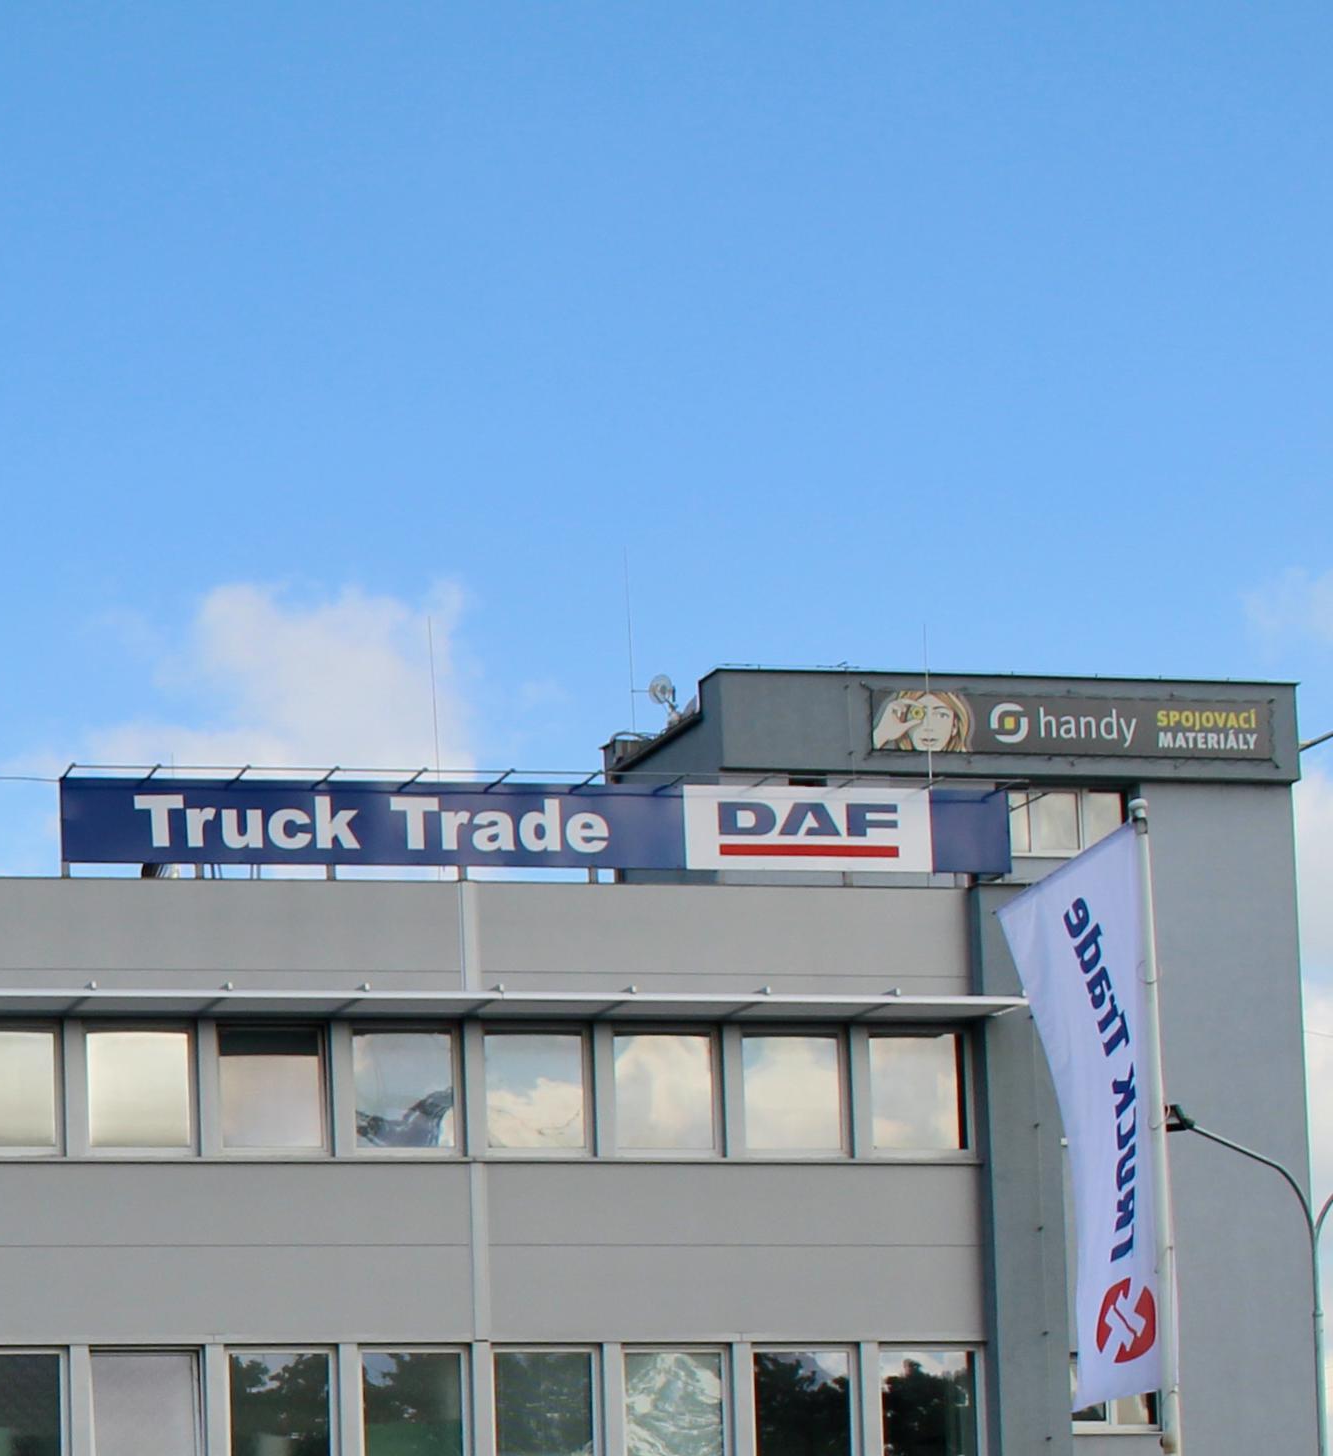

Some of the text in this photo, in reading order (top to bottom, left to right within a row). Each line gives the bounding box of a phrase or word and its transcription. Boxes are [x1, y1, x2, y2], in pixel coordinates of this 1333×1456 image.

[1039, 707, 1136, 748] handy
[1157, 708, 1256, 731] SPOJOVACÍ
[1158, 731, 1257, 750] MATERIÁLY
[134, 795, 610, 852] Truck Trade
[718, 802, 899, 836] DAF
